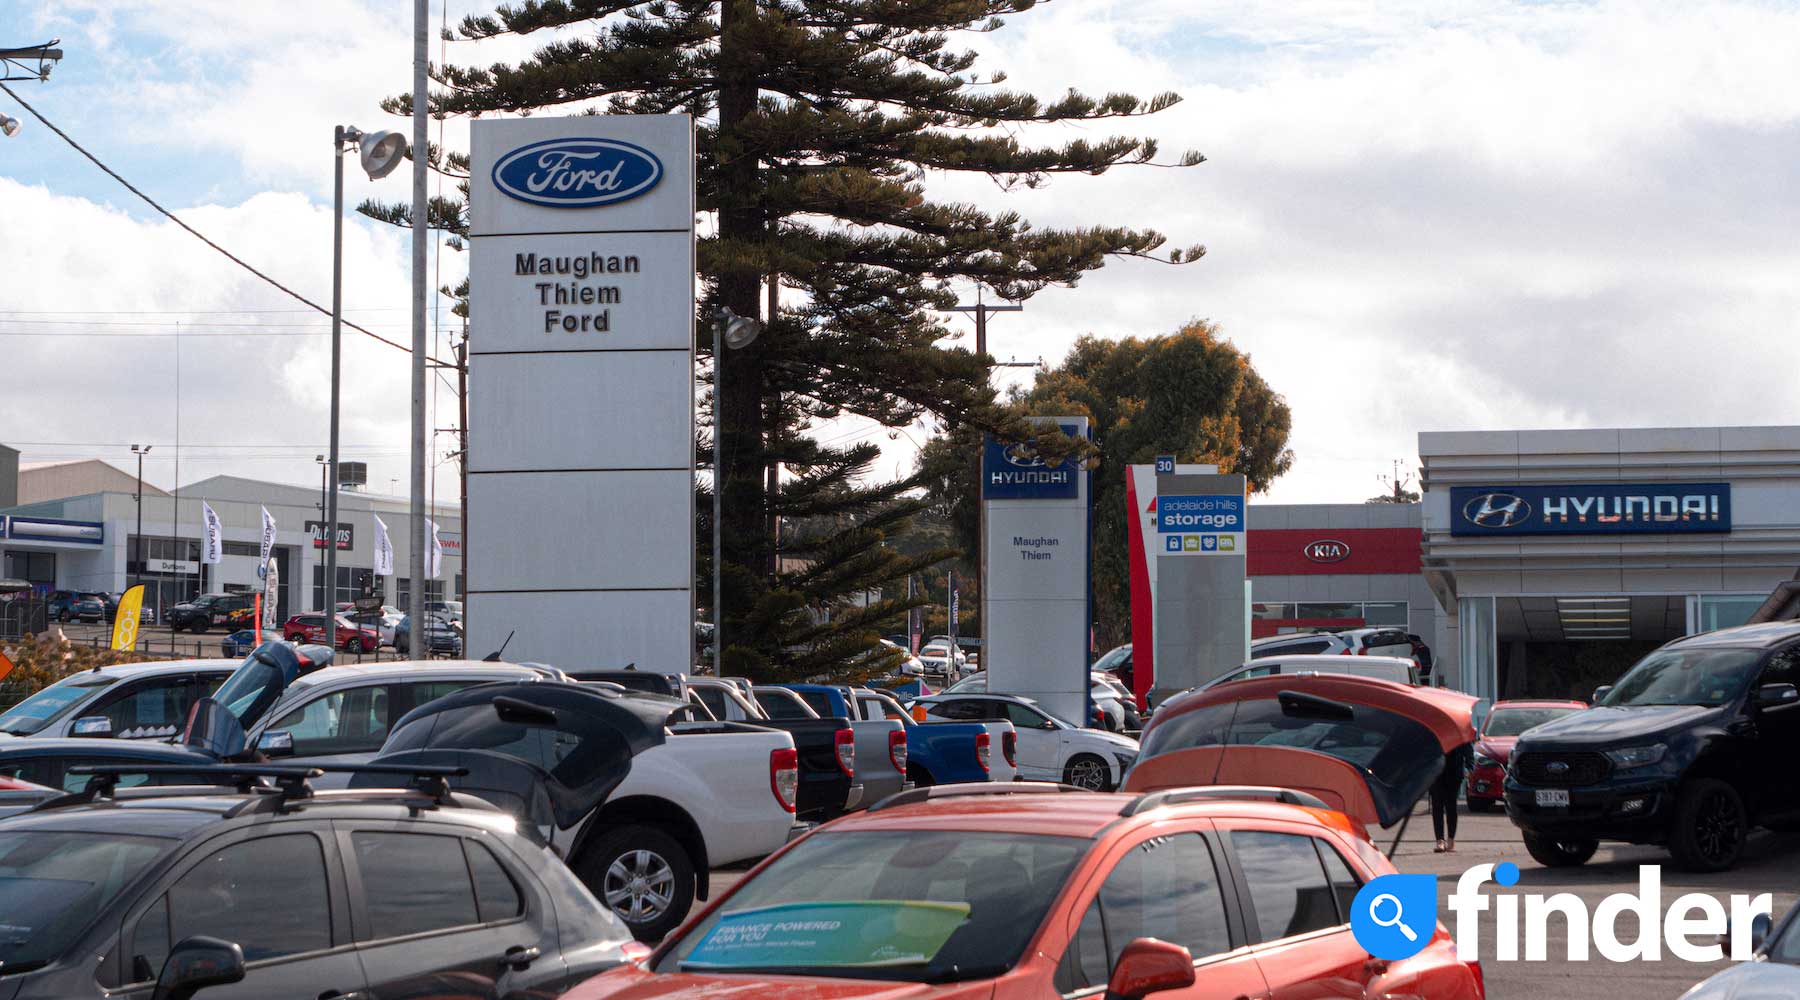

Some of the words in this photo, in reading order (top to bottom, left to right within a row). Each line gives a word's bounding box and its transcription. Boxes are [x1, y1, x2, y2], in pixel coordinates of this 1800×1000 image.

[526, 150, 625, 193] Ford
[515, 252, 641, 279] Maughan
[535, 282, 621, 305] Thiem
[544, 309, 611, 333] Ford
[1157, 460, 1172, 472] 30
[991, 471, 1068, 484] HYUNDAI
[1164, 501, 1214, 511] adelaide
[1215, 500, 1238, 511] hills
[1543, 495, 1719, 523] HYUNDAI
[1164, 512, 1238, 528] storage
[1013, 537, 1059, 547] Maughan
[1020, 551, 1051, 560] Thiem
[1314, 545, 1341, 557] KIA
[774, 920, 841, 931] POWERED
